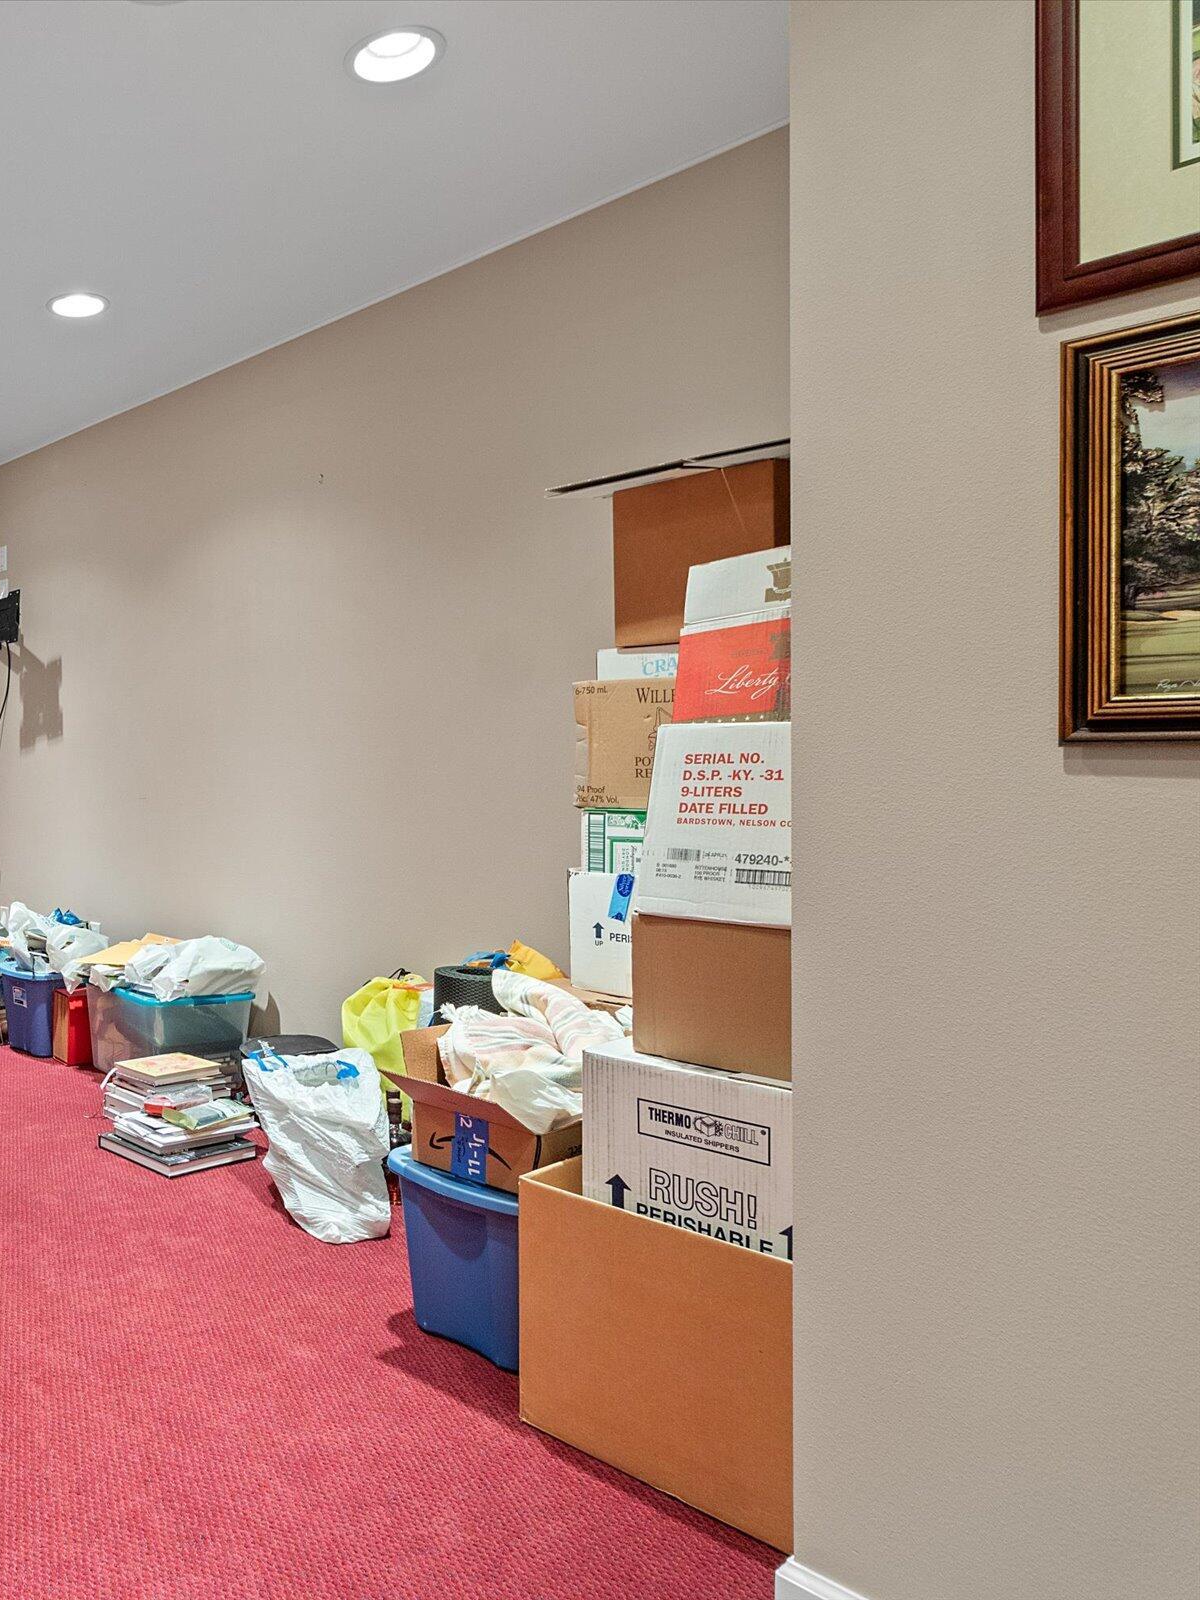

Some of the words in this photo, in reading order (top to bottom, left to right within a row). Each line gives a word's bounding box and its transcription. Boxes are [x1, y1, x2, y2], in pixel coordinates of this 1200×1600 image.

[704, 664, 779, 700] Liberty
[684, 753, 734, 764] SERIAL
[739, 752, 765, 764] NO.
[682, 769, 722, 781] D.S.P.
[680, 786, 743, 798] 9-LITERS
[679, 802, 715, 814] DATE
[718, 803, 769, 815] FILLED
[676, 817, 736, 827] BARDSTOWN,
[738, 819, 776, 828] NELSON
[648, 1106, 692, 1130] THERMO
[724, 1123, 759, 1147] CHILL
[664, 1129, 703, 1144] INSULATED
[703, 1138, 740, 1153] SHIPPERS
[649, 1167, 757, 1230] RUSH!
